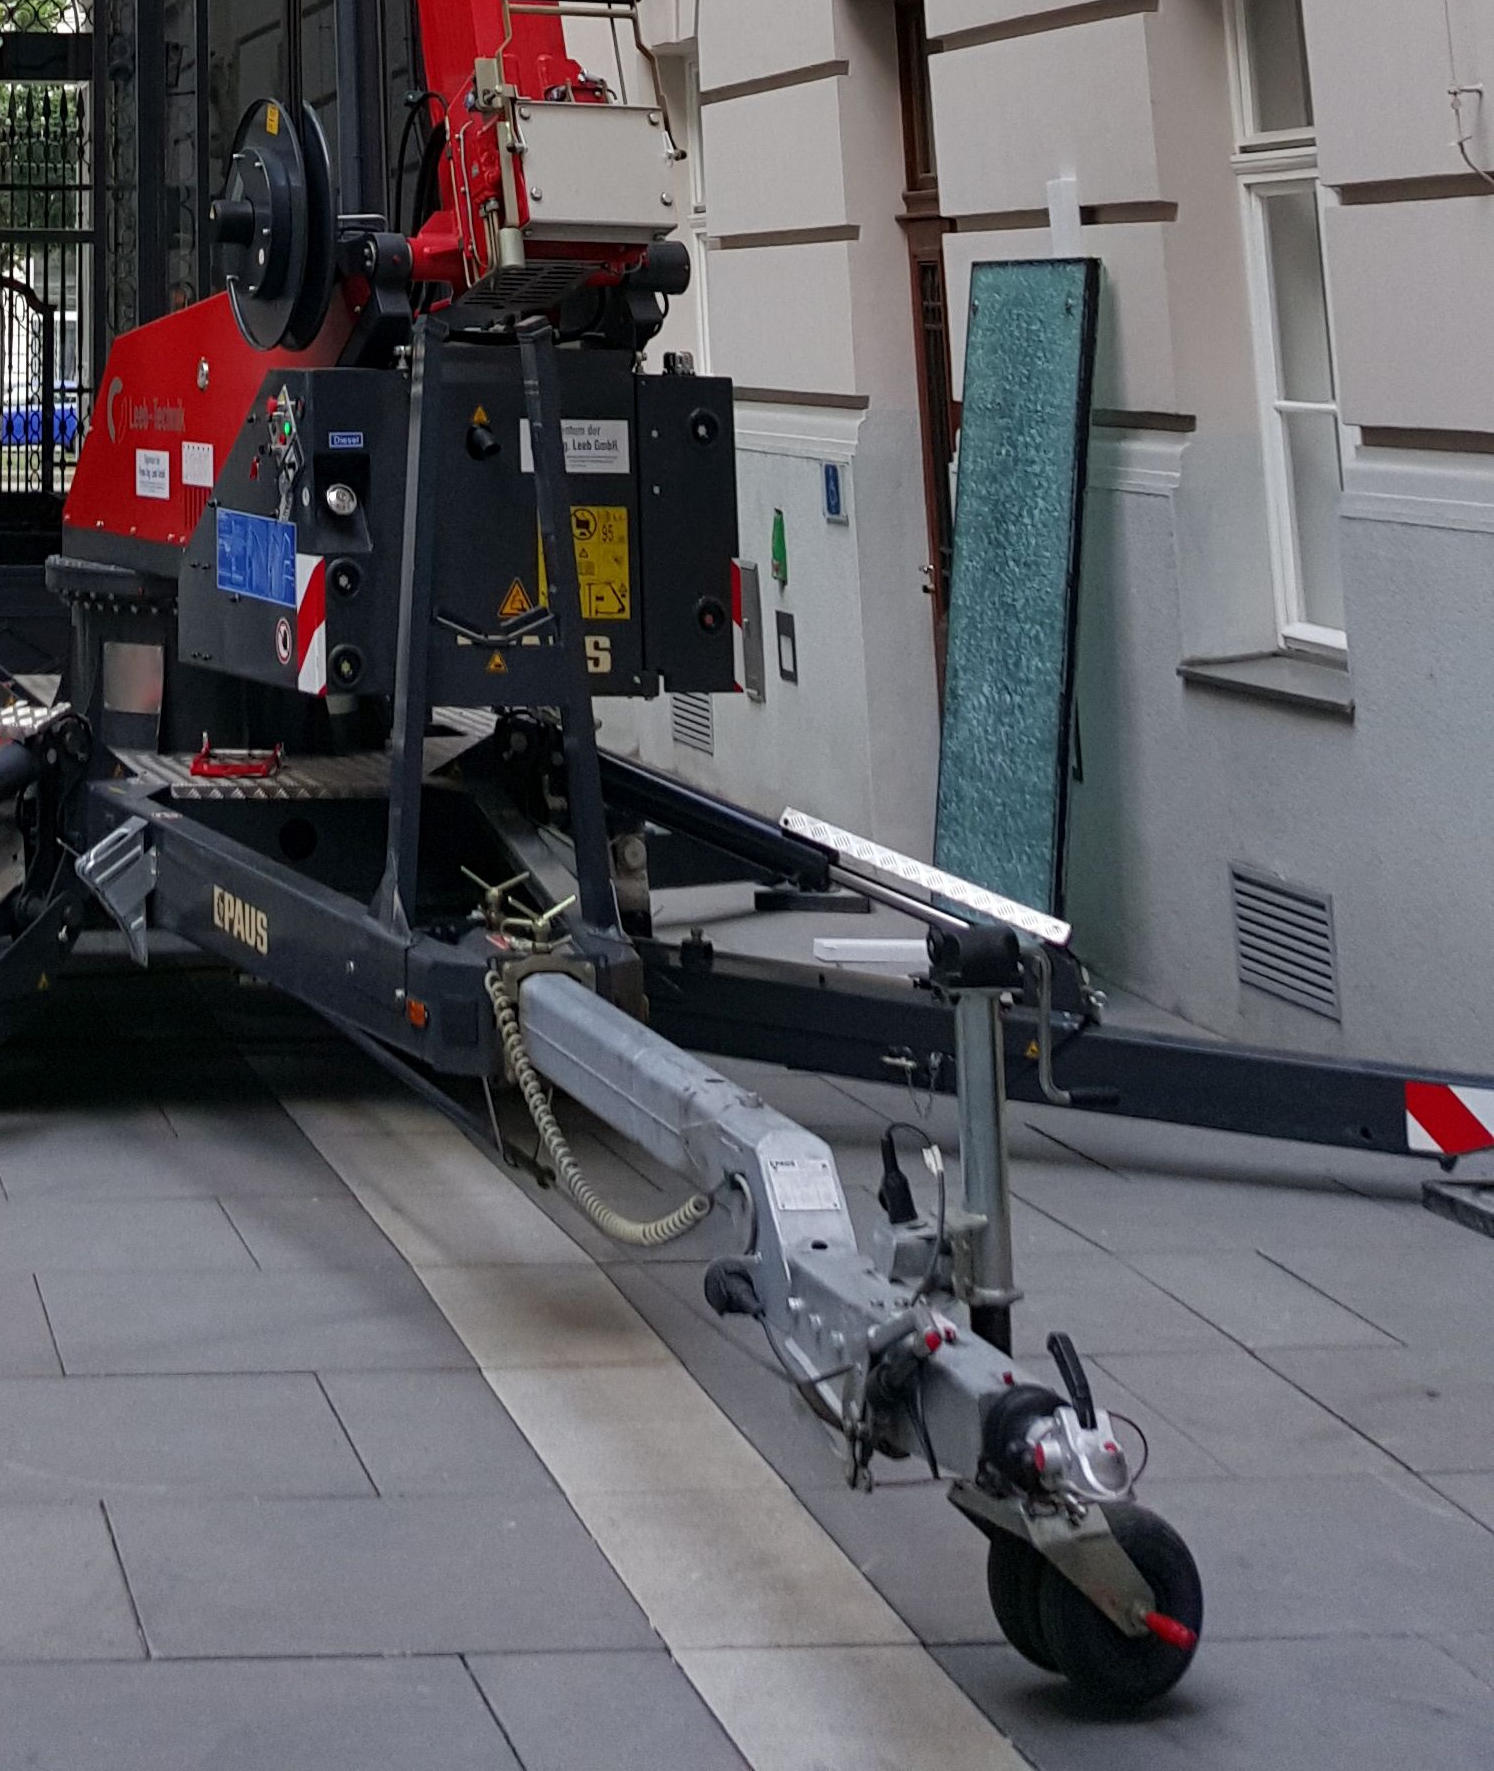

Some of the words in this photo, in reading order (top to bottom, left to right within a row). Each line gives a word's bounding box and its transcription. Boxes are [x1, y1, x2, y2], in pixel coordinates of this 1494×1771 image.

[333, 435, 360, 446] Diesel
[572, 438, 592, 451] Leeb
[594, 439, 619, 452] GmbH
[601, 523, 614, 542] 95
